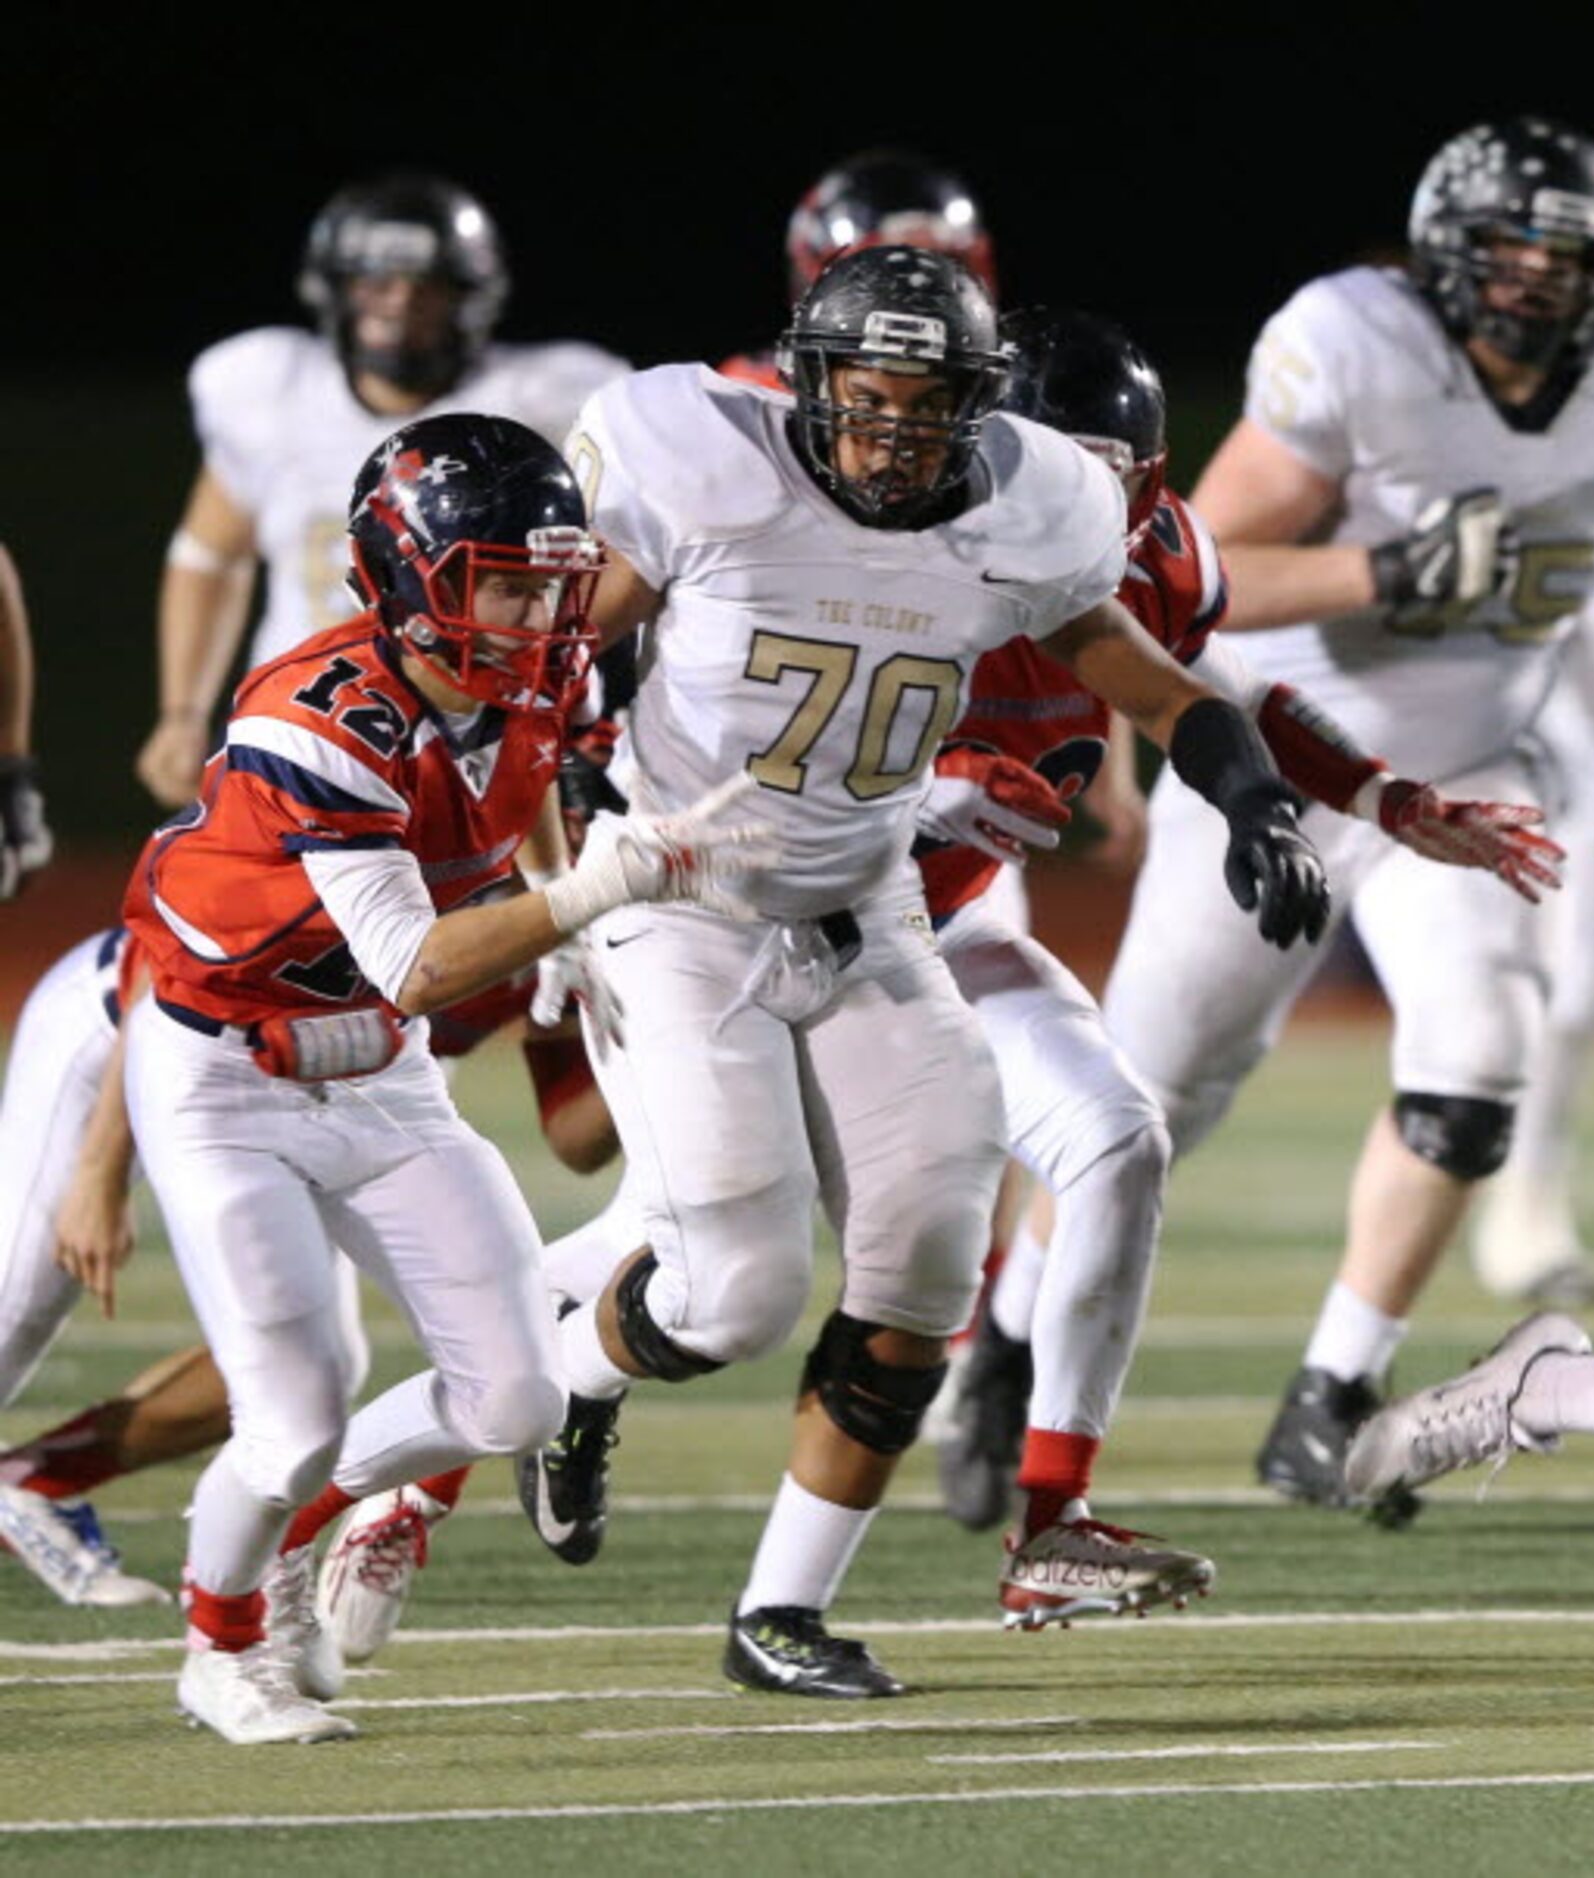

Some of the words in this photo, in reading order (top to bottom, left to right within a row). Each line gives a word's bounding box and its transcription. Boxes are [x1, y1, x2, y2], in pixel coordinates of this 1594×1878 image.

[816, 598, 851, 625] THE
[292, 655, 408, 761] 12
[743, 628, 964, 801] 70
